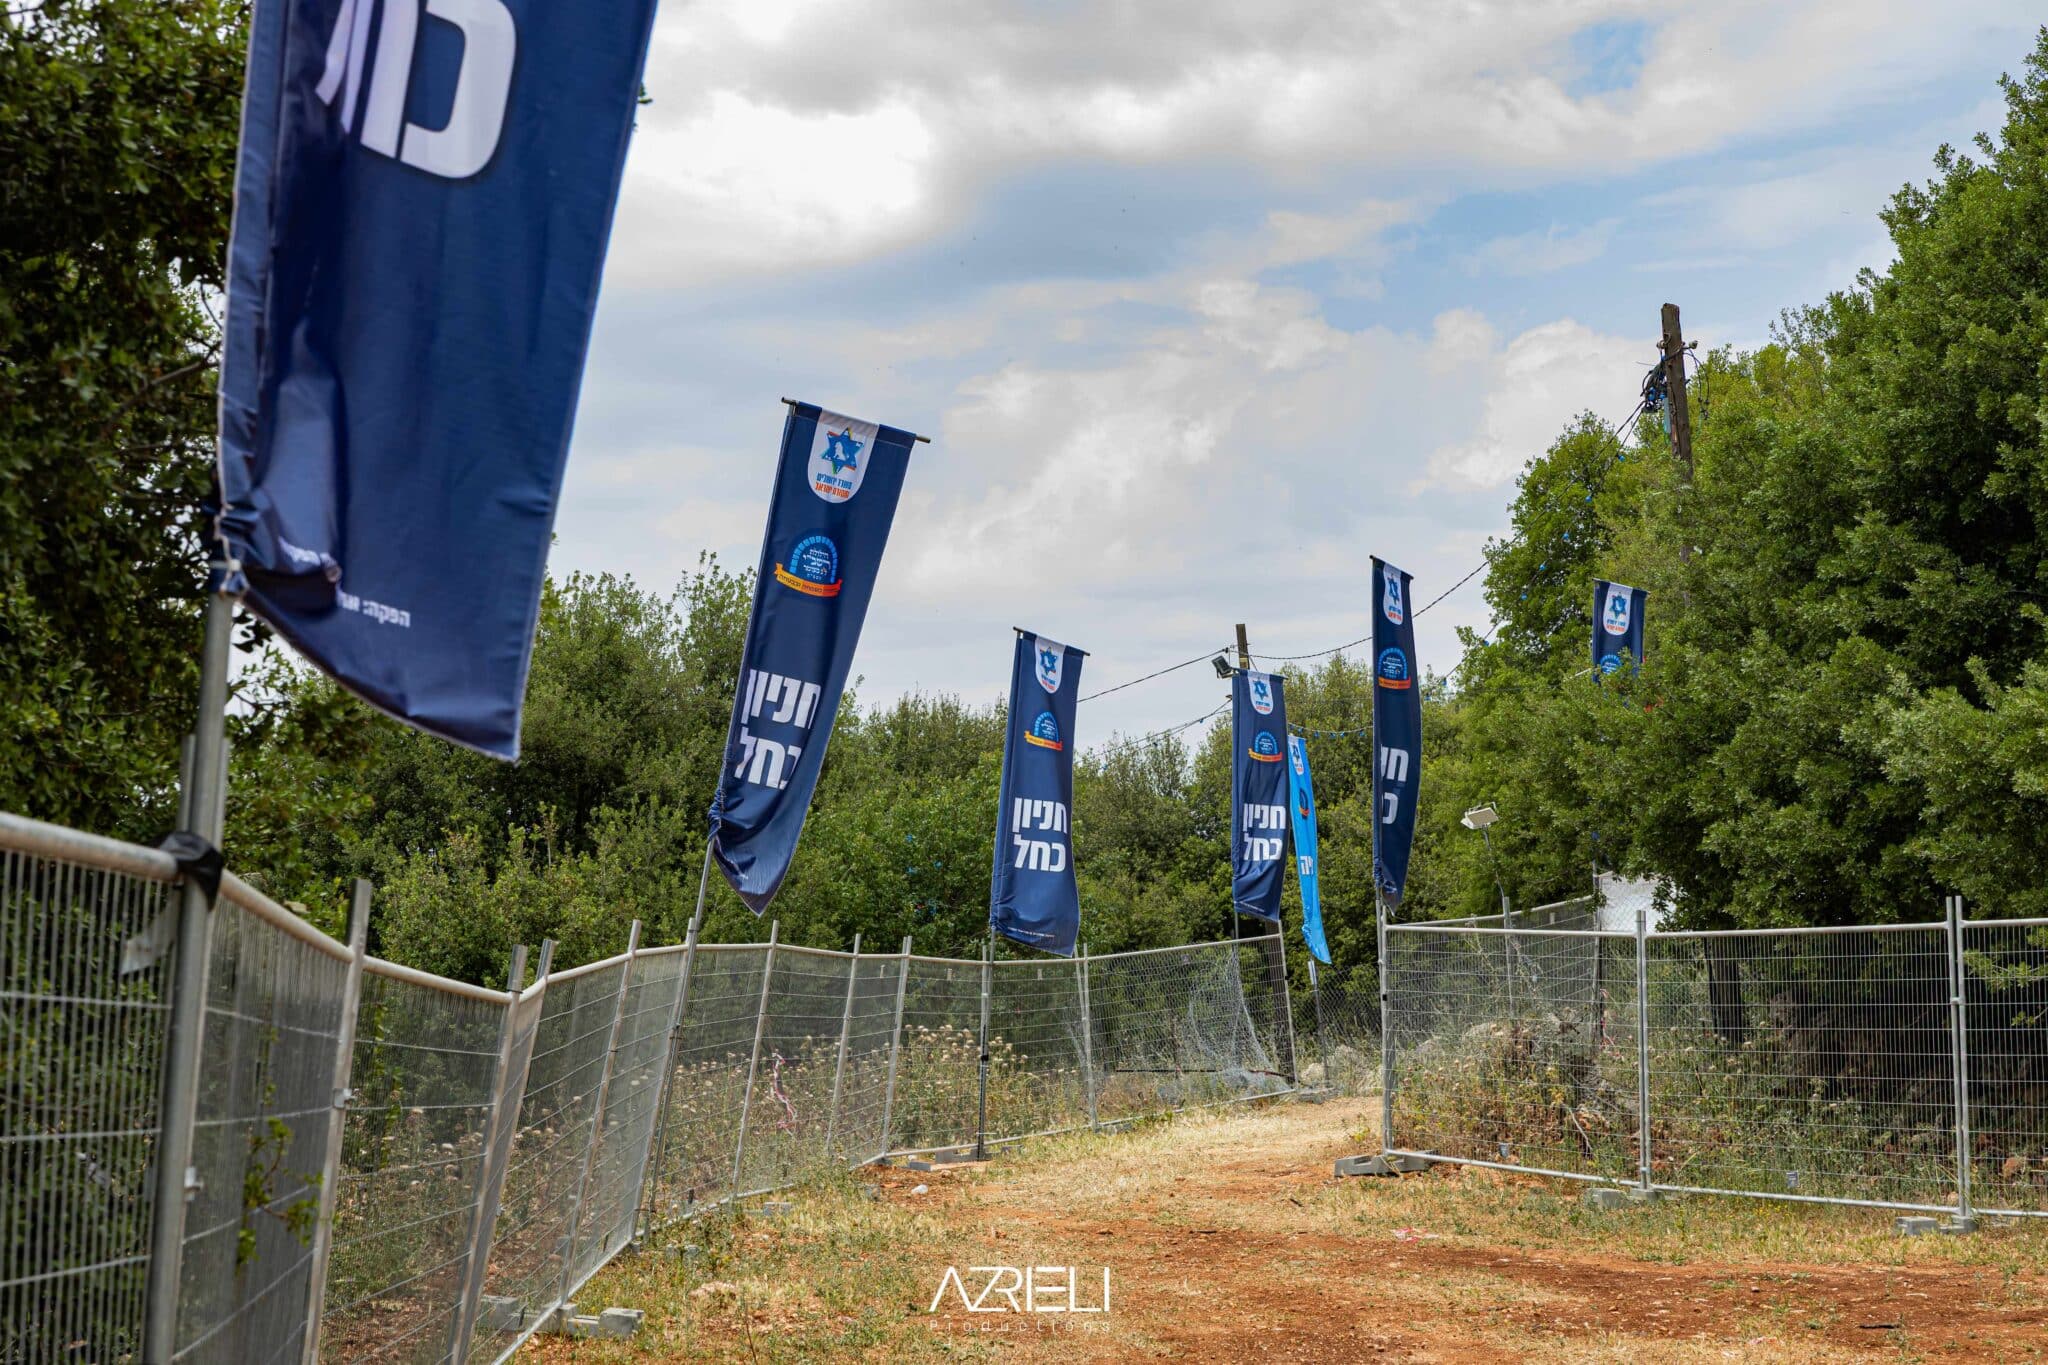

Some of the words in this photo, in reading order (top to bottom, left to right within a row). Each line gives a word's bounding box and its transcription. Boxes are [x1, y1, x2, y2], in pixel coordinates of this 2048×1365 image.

[741, 669, 821, 729] חניון
[734, 726, 802, 790] כחל
[1012, 797, 1067, 834] חניון
[1243, 803, 1286, 832] חניון
[1013, 834, 1066, 872] כחל
[1244, 832, 1283, 862] כחל
